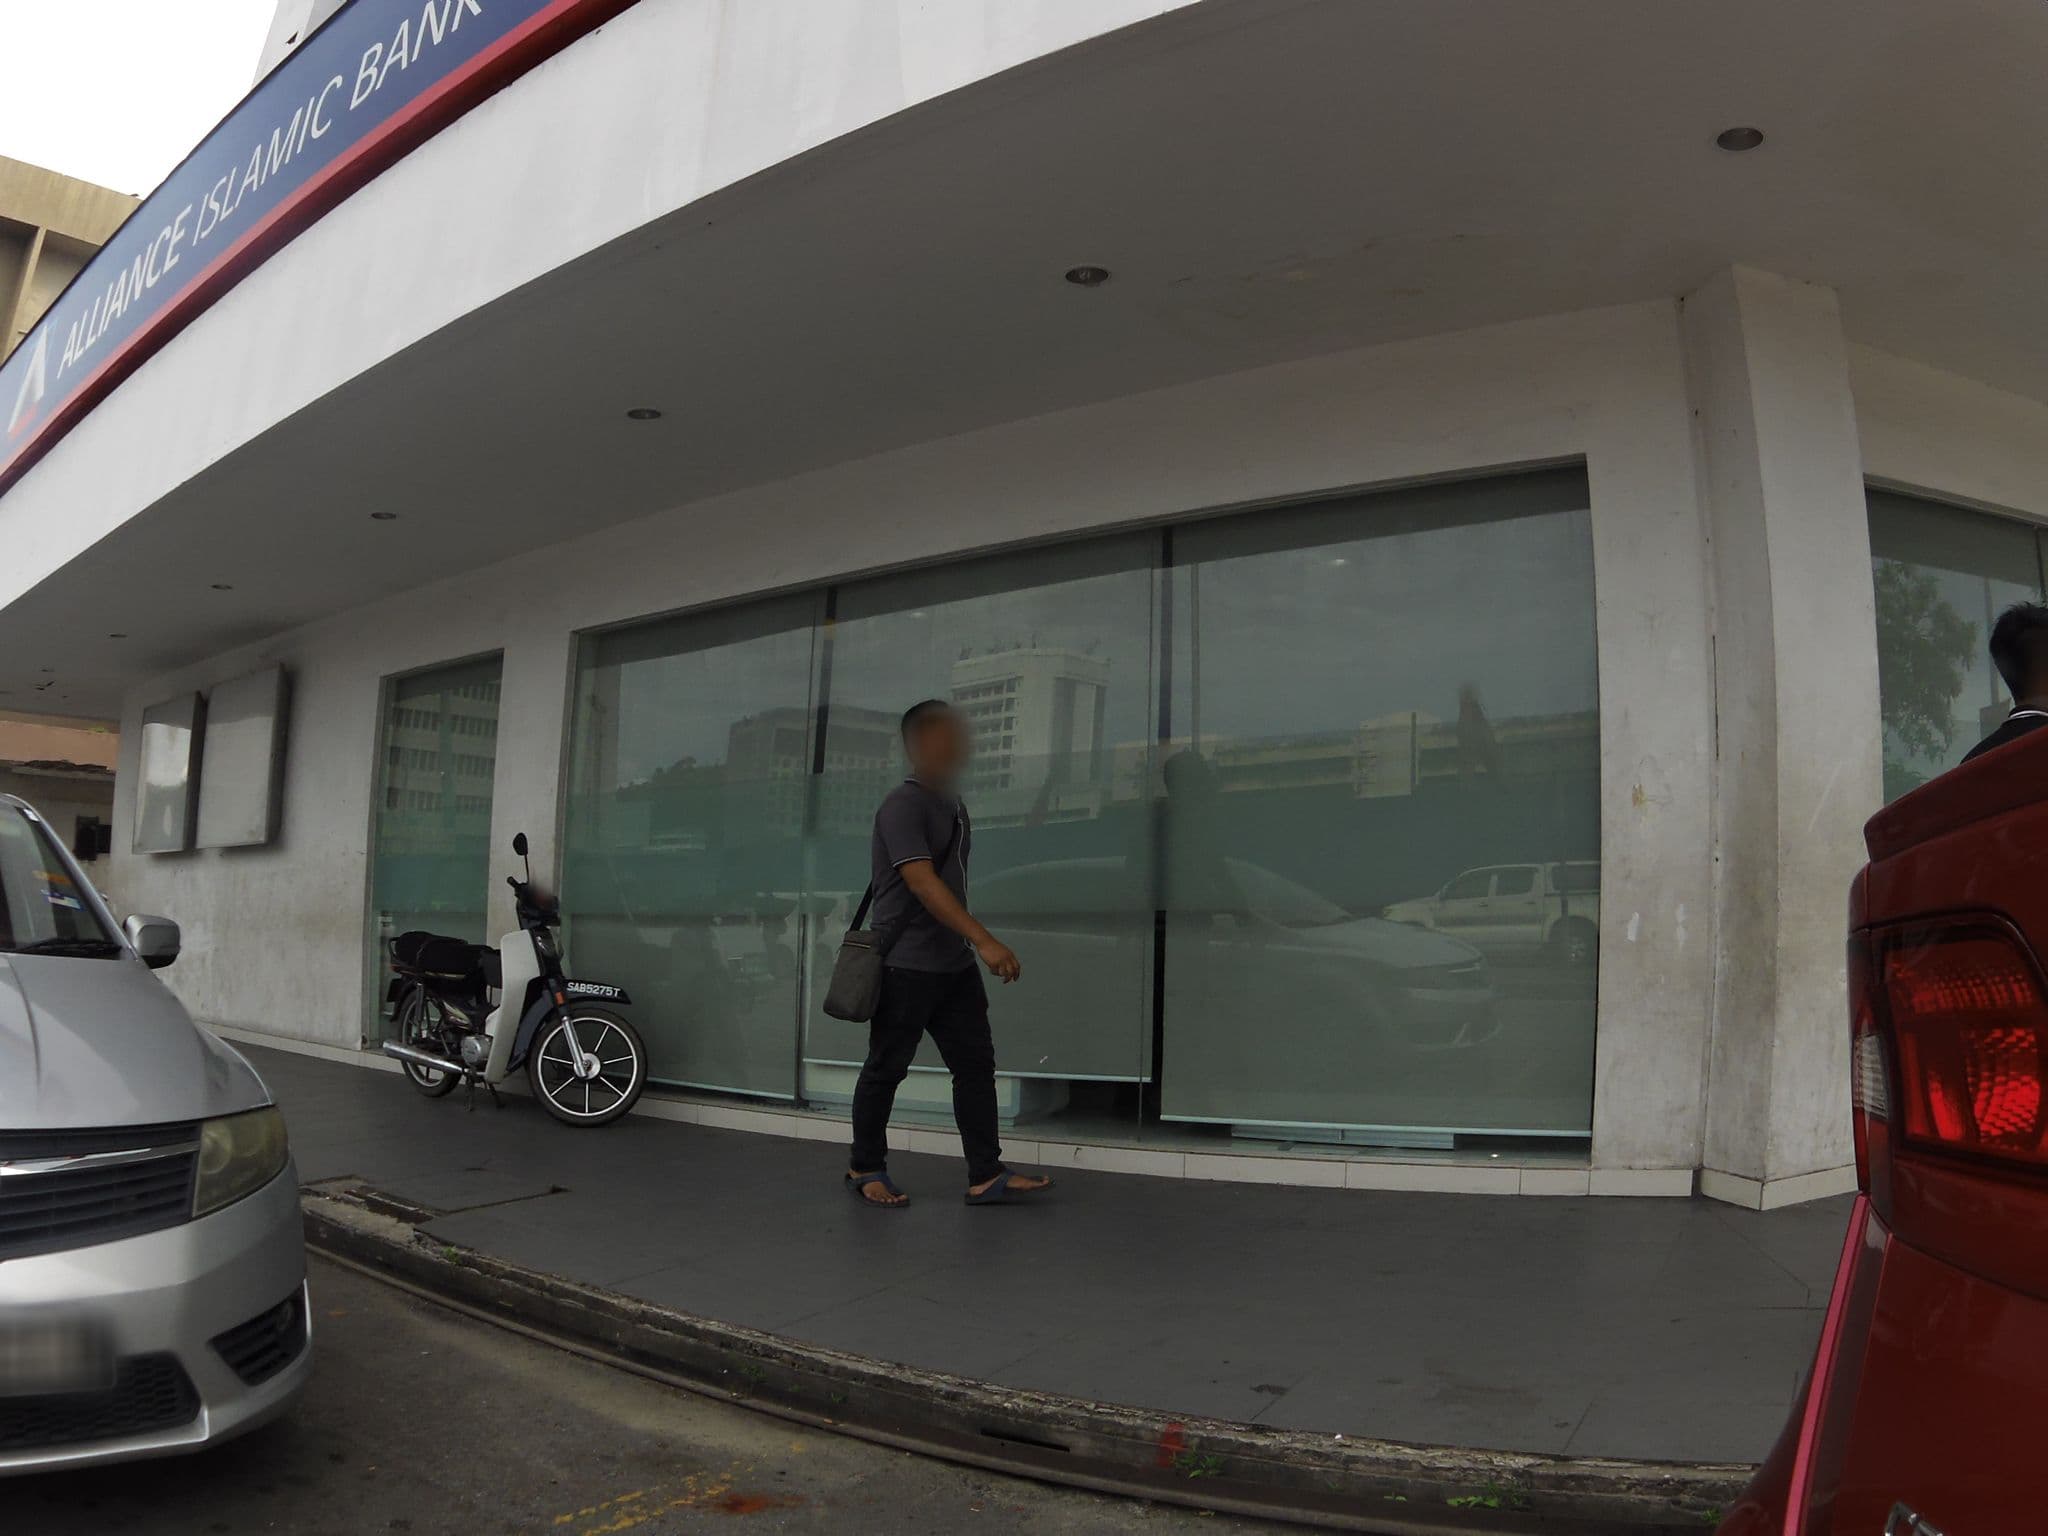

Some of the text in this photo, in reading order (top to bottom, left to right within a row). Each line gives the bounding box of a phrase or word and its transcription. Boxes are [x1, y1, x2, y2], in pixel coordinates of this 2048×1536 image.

[57, 203, 192, 379] ALLIANCE
[192, 75, 343, 247] ISLAMIC
[566, 982, 621, 998] SAB5275T
